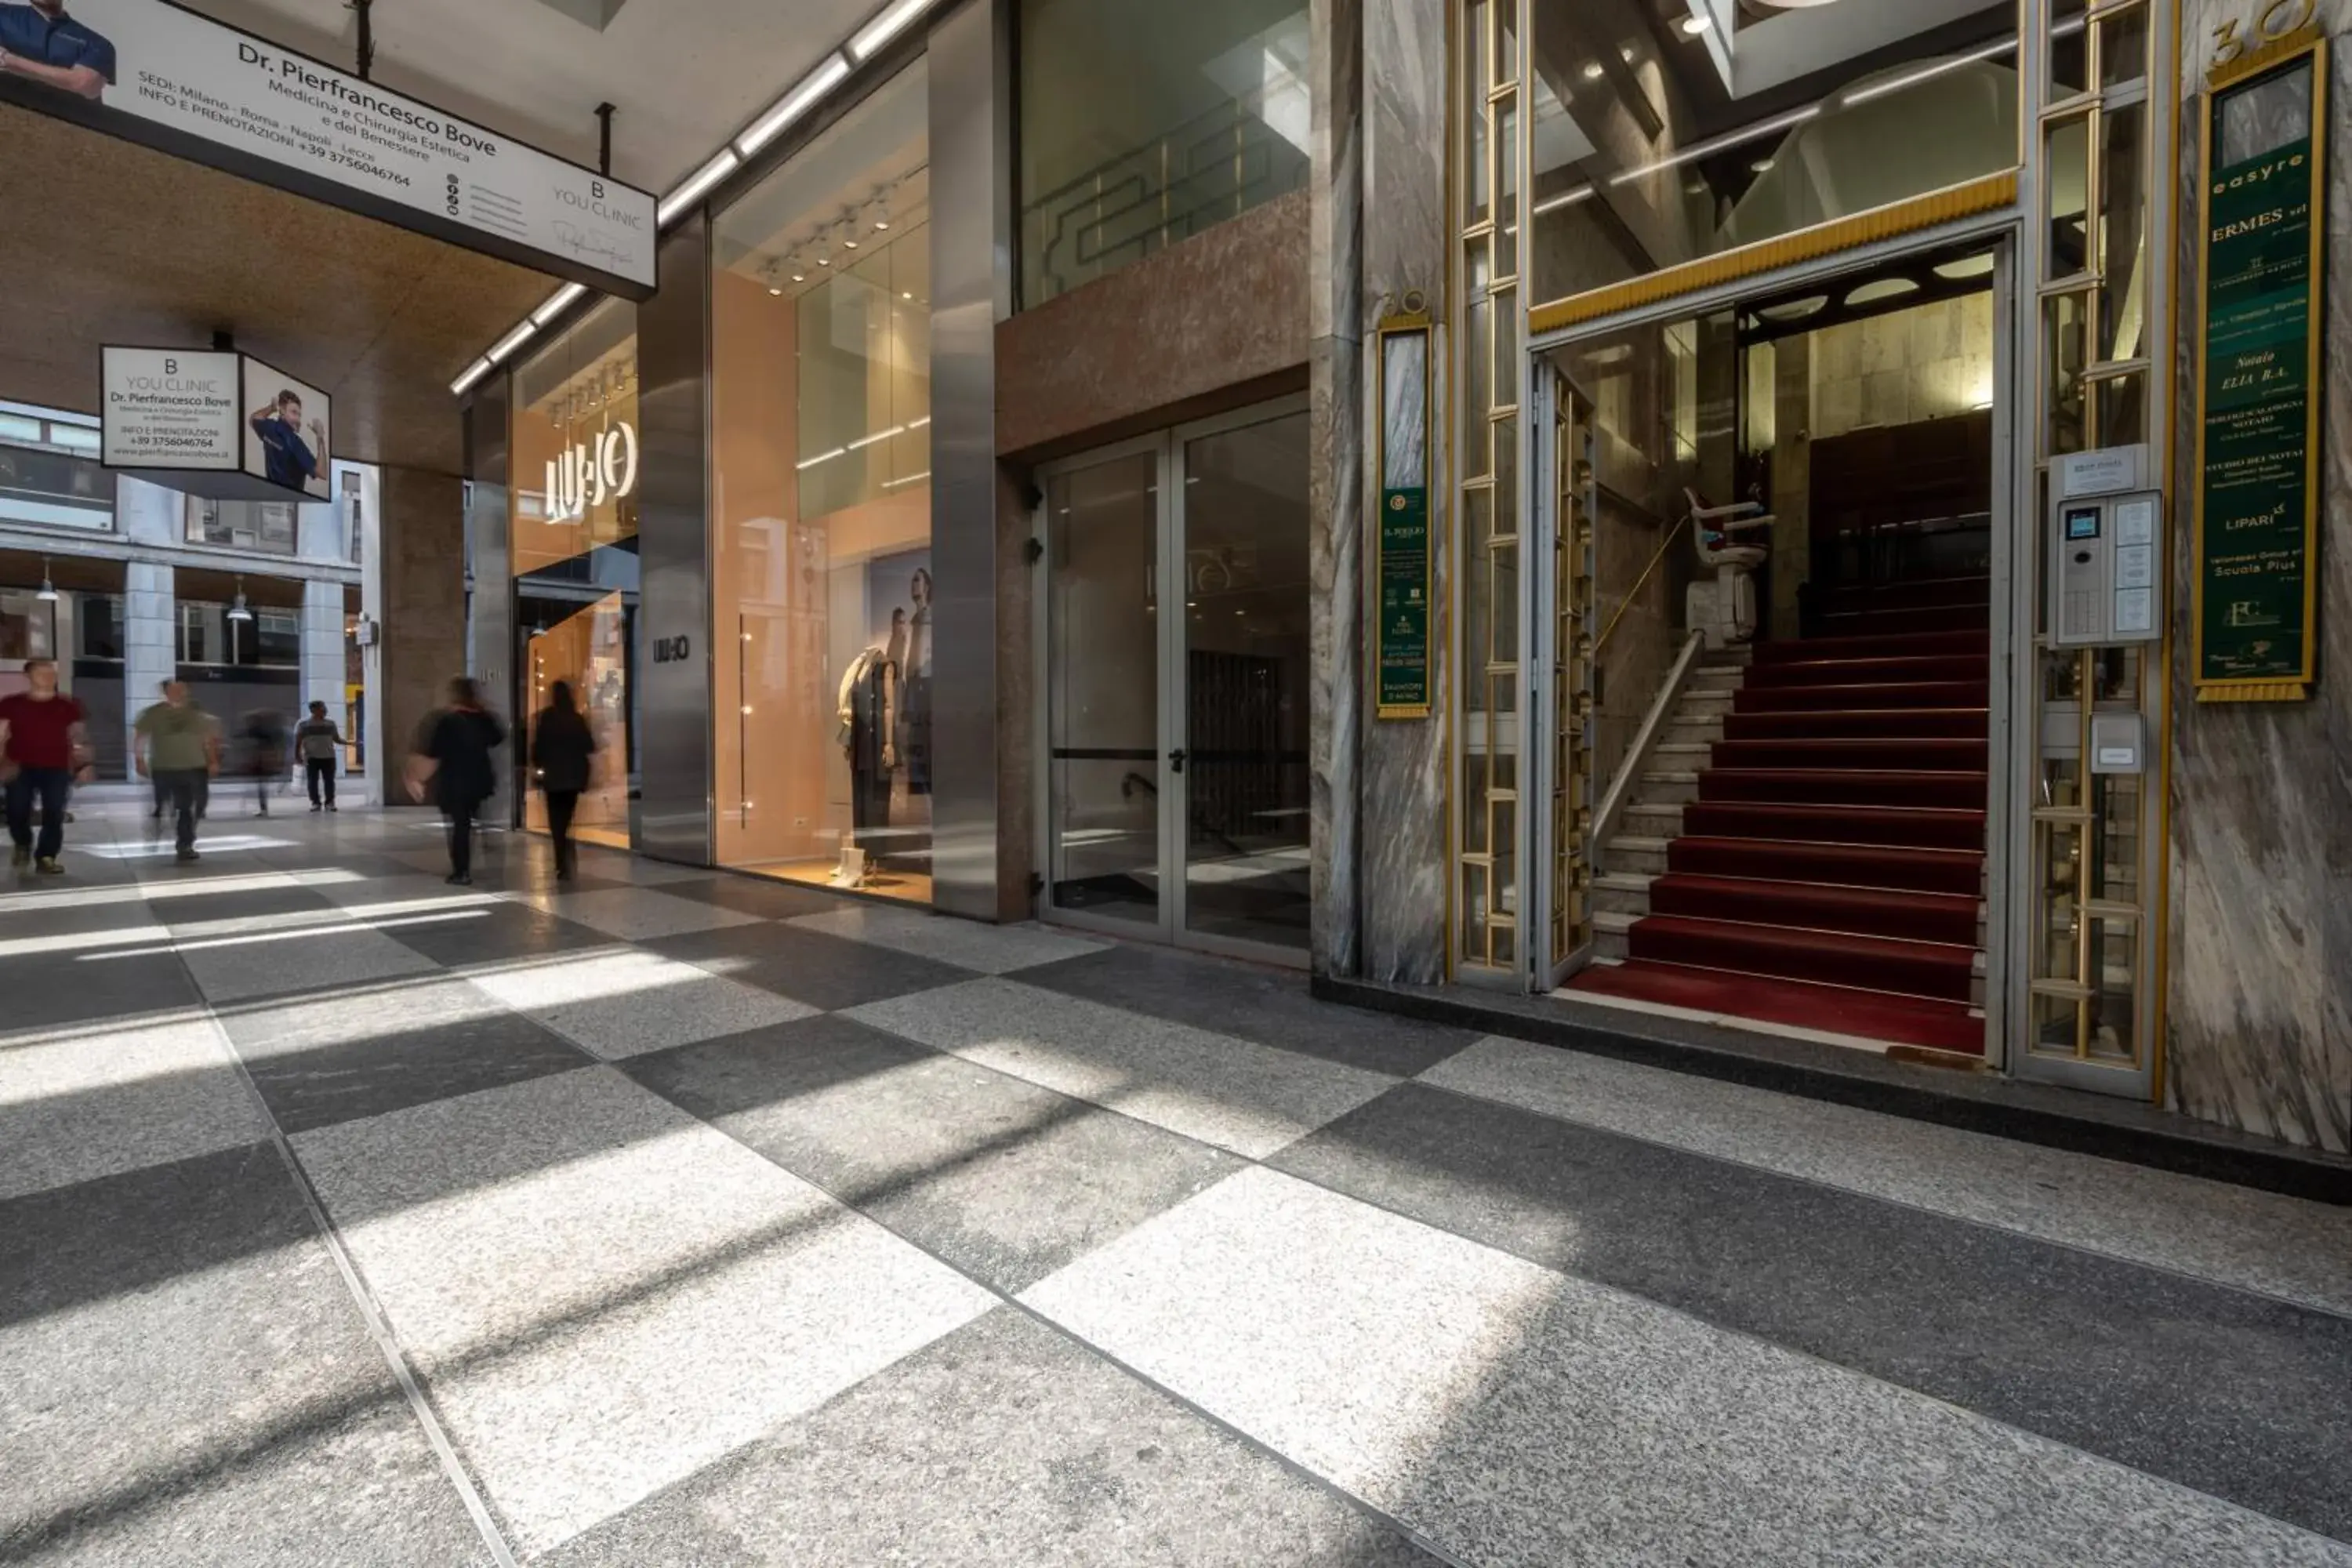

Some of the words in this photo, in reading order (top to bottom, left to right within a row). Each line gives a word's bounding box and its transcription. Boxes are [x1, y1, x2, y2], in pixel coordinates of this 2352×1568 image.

[138, 71, 176, 93] SEDI:
[180, 85, 229, 111] Milano
[241, 107, 279, 129] Roma
[290, 125, 332, 147] Napoli
[238, 42, 274, 72] Dr.
[282, 60, 440, 134] Pierfrancesco
[445, 123, 497, 157] Bove
[139, 85, 176, 107] INFO
[180, 100, 188, 111] E
[191, 103, 295, 147] PRENOTAZIONI
[298, 143, 325, 158] +39
[328, 153, 411, 187] 3756046764
[269, 79, 338, 114] Medicina
[342, 108, 350, 118] e
[353, 111, 418, 144] Chirurgia
[421, 136, 470, 163] Estetica
[321, 116, 331, 126] e
[335, 118, 357, 136] del
[361, 128, 430, 161] Benessere
[553, 186, 588, 210] YOU
[592, 201, 643, 230] CLINIC
[592, 181, 604, 198] B
[2211, 207, 2284, 243] ERMES
[126, 376, 162, 390] YOU
[165, 378, 219, 393] CLINIC
[165, 359, 178, 375] B
[111, 392, 126, 402] Dr.
[129, 394, 202, 406] Pierfrancesco
[205, 396, 231, 408] Bove
[2226, 514, 2274, 531] LIPARI
